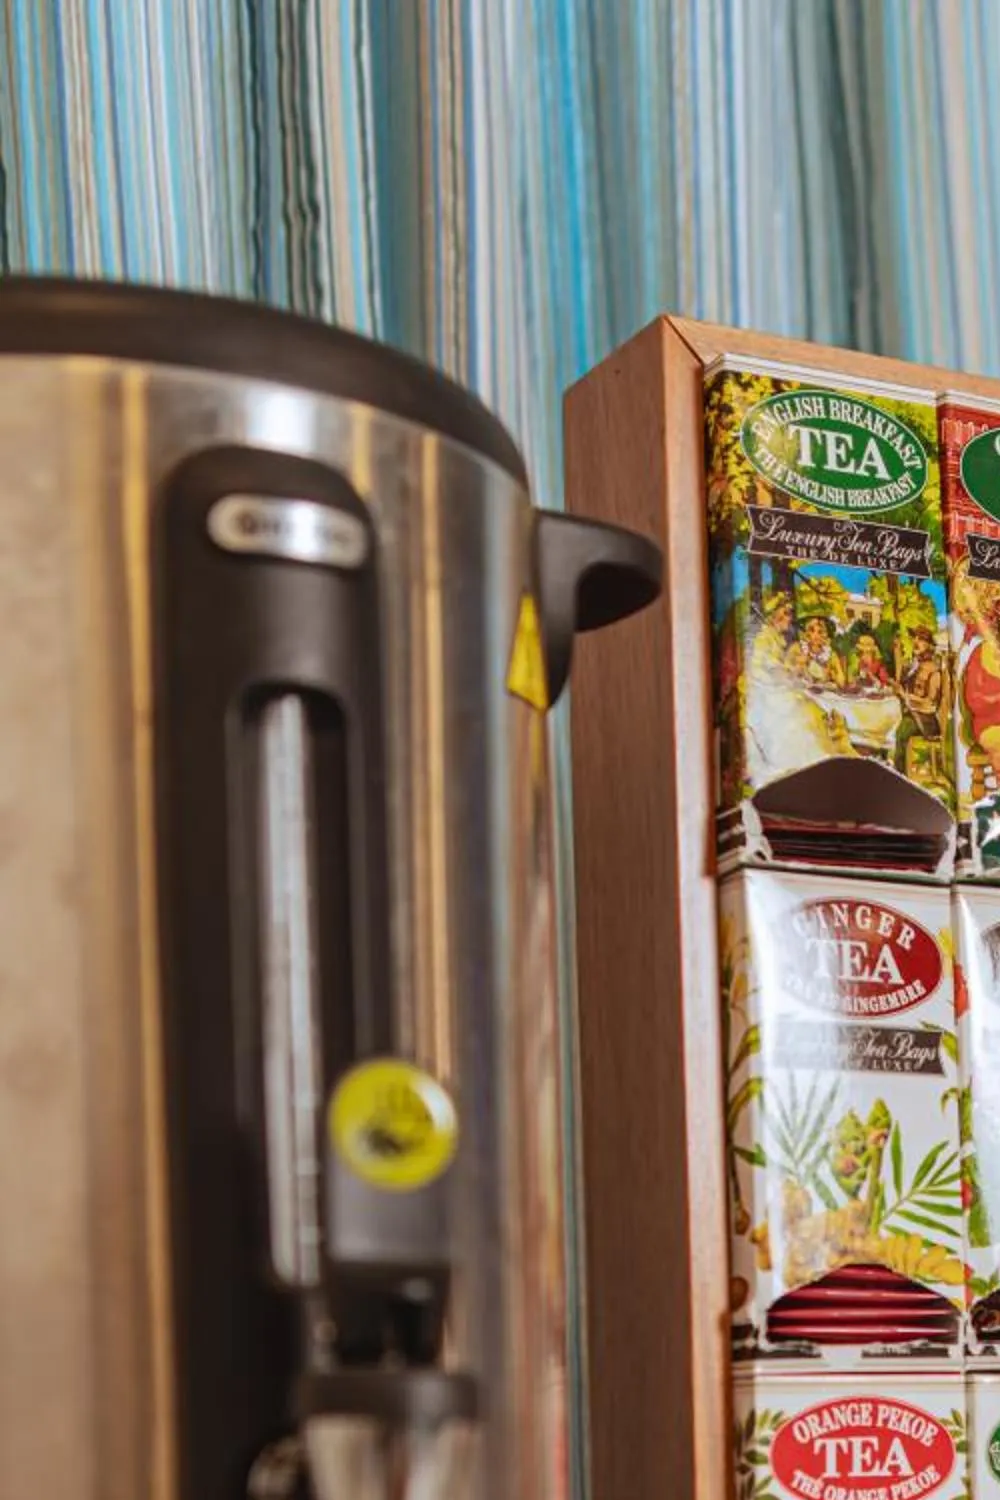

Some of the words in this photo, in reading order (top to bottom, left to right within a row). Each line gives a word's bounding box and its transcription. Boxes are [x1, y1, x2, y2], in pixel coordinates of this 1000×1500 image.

[752, 396, 827, 441] ENGLISH
[829, 398, 922, 469] BREAKFAST
[789, 423, 893, 481] TEA
[784, 469, 846, 506] ENGLISH
[848, 471, 917, 508] BREAKFAST
[757, 511, 839, 552] Luxury
[833, 521, 872, 554] Tea
[871, 530, 934, 569] Bags
[791, 903, 916, 950] GINGER
[806, 937, 905, 985] TEA
[887, 1031, 937, 1067] Bags
[792, 1403, 873, 1445] ORANGE
[876, 1404, 939, 1447] PEKOE
[813, 1436, 915, 1479] TEA
